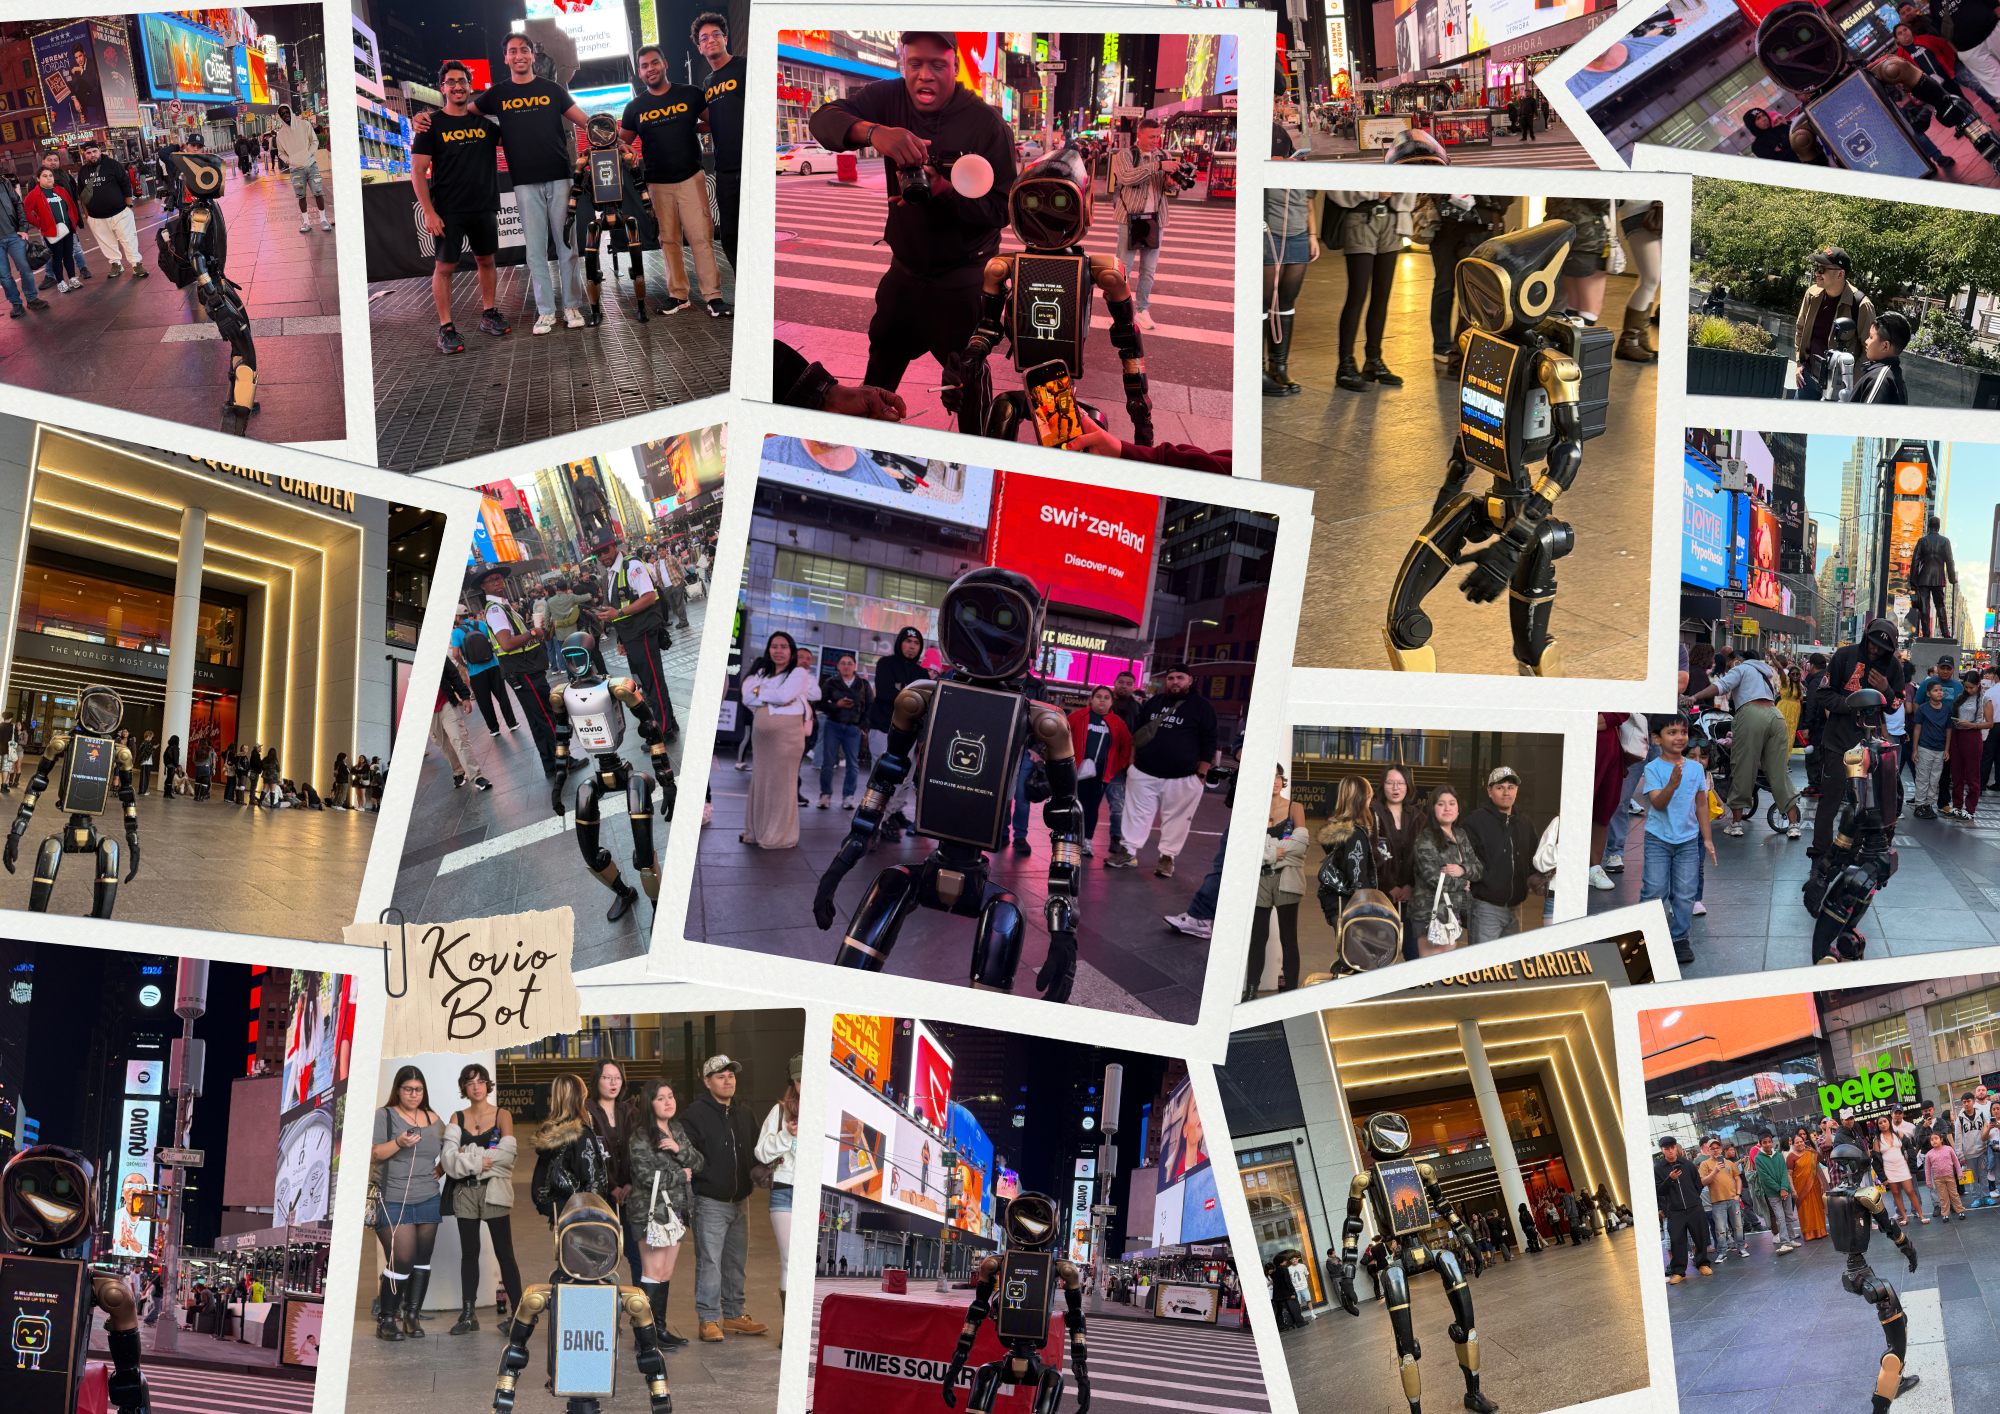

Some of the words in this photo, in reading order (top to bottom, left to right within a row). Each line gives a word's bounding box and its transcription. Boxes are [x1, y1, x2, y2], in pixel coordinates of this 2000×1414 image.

[1840, 1, 1876, 32] MEGAMART
[580, 31, 611, 42] world's
[1506, 21, 1530, 35] SEPHORA
[576, 42, 612, 55] grapher.
[1330, 22, 1339, 58] LAMBERT
[1336, 22, 1344, 58] MIRANDA
[1503, 36, 1543, 57] SEPHORA
[40, 51, 69, 65] JEREMY
[41, 57, 71, 75] JORDAN
[205, 58, 233, 83] CARRIE
[236, 64, 248, 76] prime
[501, 95, 551, 111] KOVIO
[639, 102, 689, 124] KOVIO
[441, 127, 486, 143] KOVIO
[1462, 386, 1505, 419] CHAMPIONS
[1686, 503, 1720, 540] LOVE
[1691, 539, 1724, 567] Hypothesis
[1064, 553, 1107, 572] Discover
[1107, 567, 1125, 579] now
[1056, 631, 1107, 651] MEGAMART
[50, 645, 69, 655] THE
[73, 649, 115, 663] WORLD'S
[119, 656, 144, 667] MOST
[193, 670, 215, 679] RENA
[578, 725, 603, 734] KOVIO
[142, 965, 163, 975] 2026
[1519, 950, 1593, 980] GARDEN
[833, 1014, 879, 1066] CLUB
[1817, 1053, 1895, 1119] pelé
[1895, 1062, 1917, 1103] pelé
[127, 1108, 150, 1157] QUAVO
[161, 1152, 176, 1160] ONE
[182, 1153, 198, 1161] WAY
[1454, 1158, 1476, 1168] MOST
[1077, 1184, 1088, 1212] QUAVO
[295, 1227, 317, 1235] PEDESTRIAN
[563, 1330, 609, 1352] BANG.
[844, 1350, 901, 1375] TIMES
